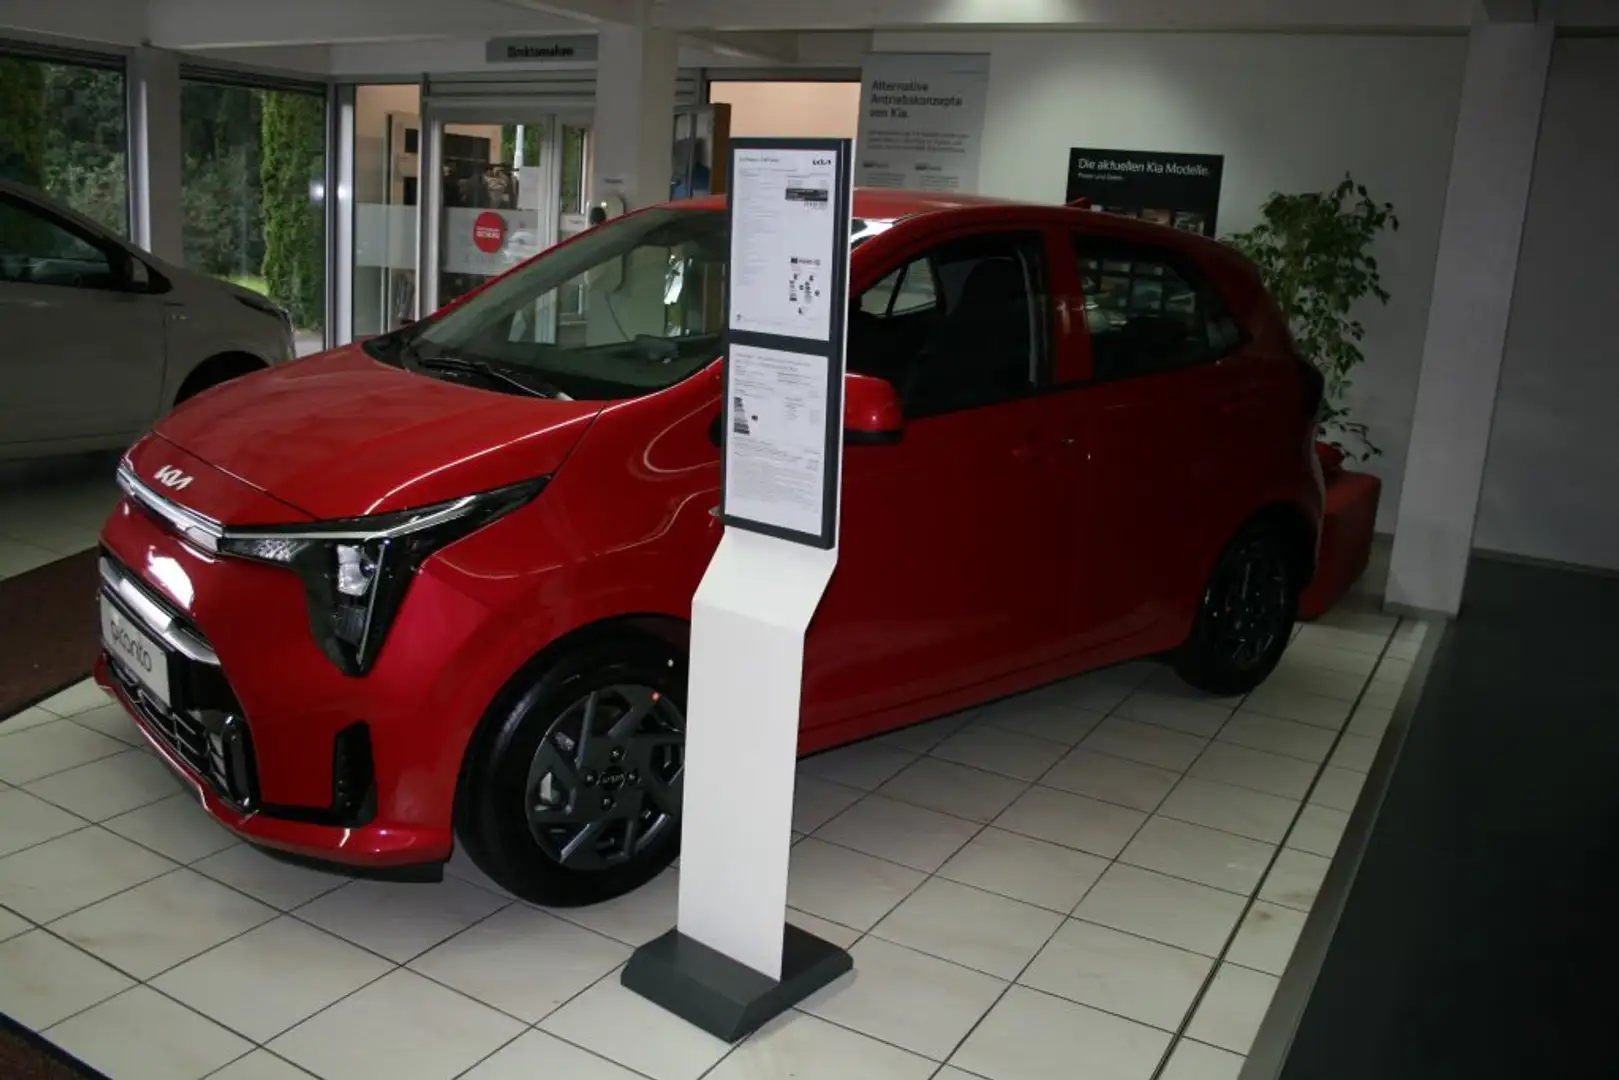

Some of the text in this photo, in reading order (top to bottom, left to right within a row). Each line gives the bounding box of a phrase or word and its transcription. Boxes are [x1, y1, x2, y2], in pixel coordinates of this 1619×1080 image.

[871, 80, 929, 92] Alternative
[870, 94, 963, 108] Antriebskonzepte
[1078, 158, 1096, 170] Die
[1097, 159, 1144, 173] aktuellen
[1146, 160, 1164, 174] Kia
[153, 464, 194, 491] KIA
